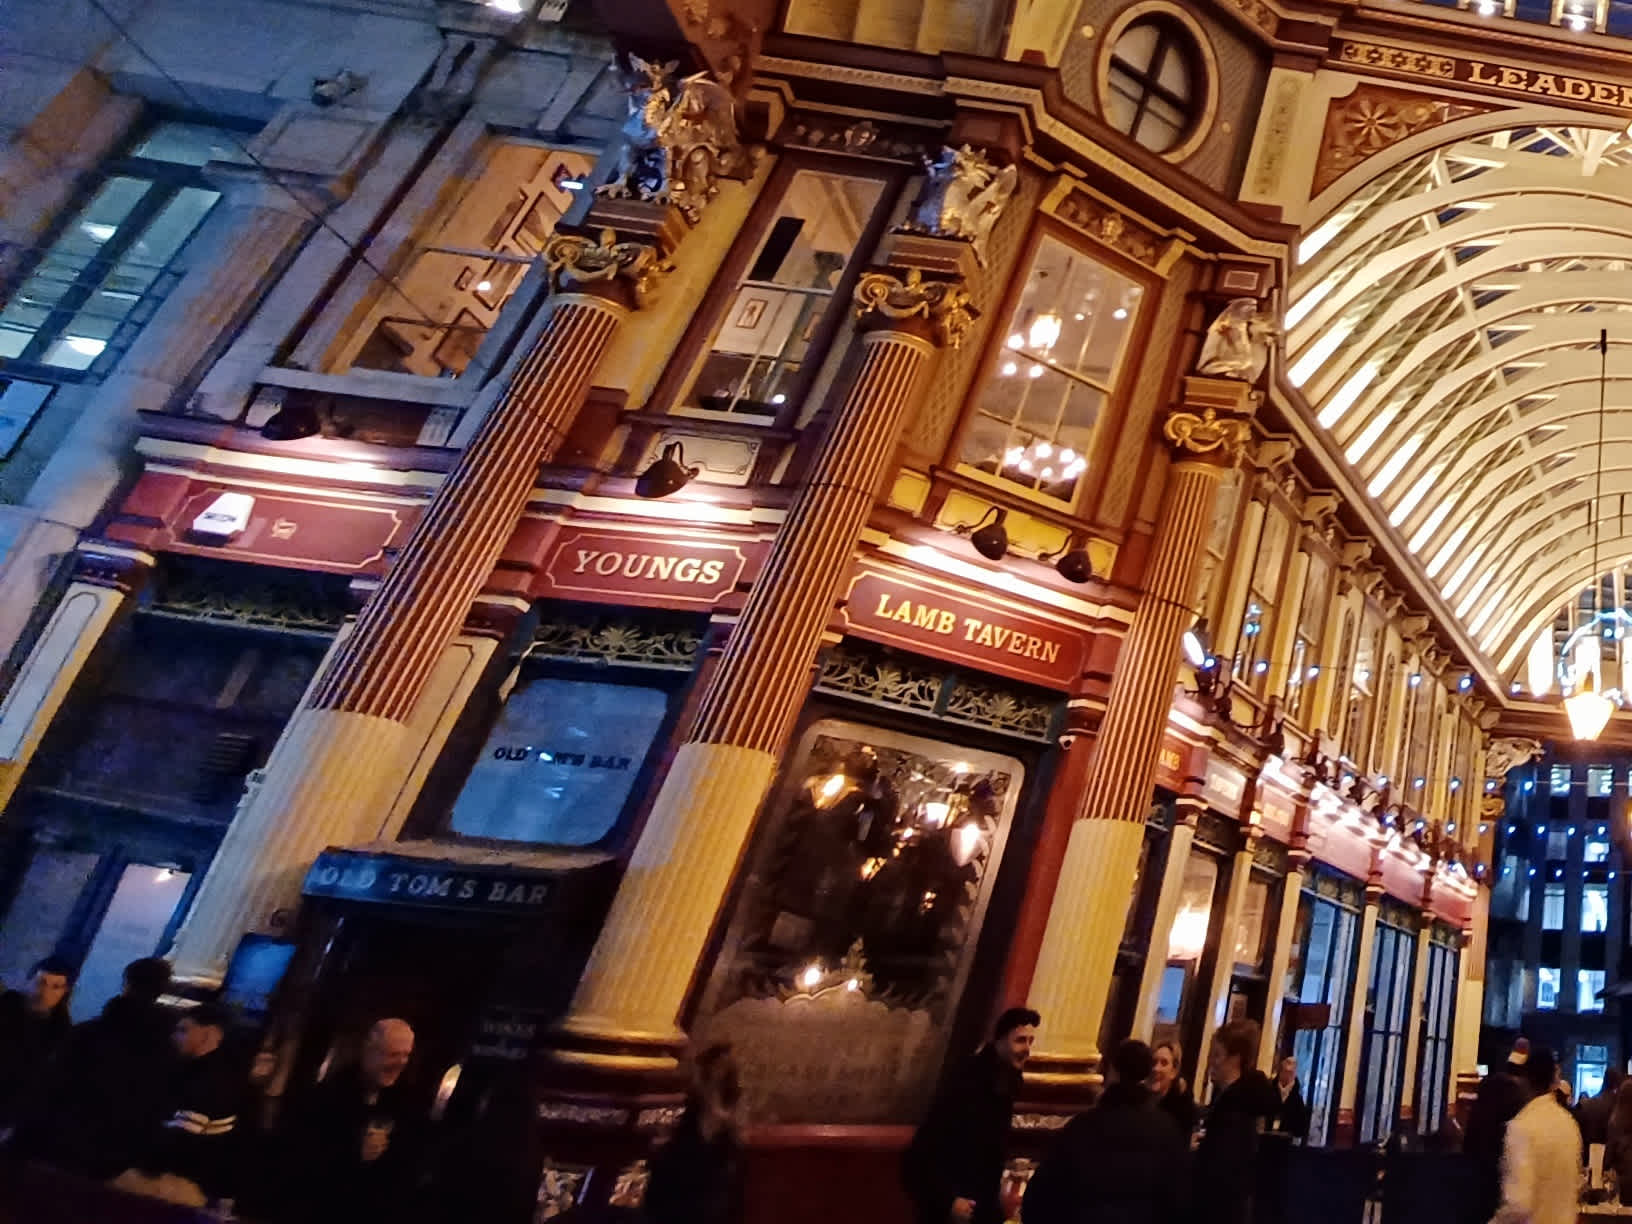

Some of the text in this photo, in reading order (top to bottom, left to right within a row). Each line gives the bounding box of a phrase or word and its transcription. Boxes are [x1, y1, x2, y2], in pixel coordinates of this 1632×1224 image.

[573, 549, 725, 584] YOUNGS
[874, 593, 1062, 664] LAMB TAVERN
[494, 746, 528, 761] OLD
[318, 866, 377, 889] OLD
[487, 881, 549, 904] BAR
